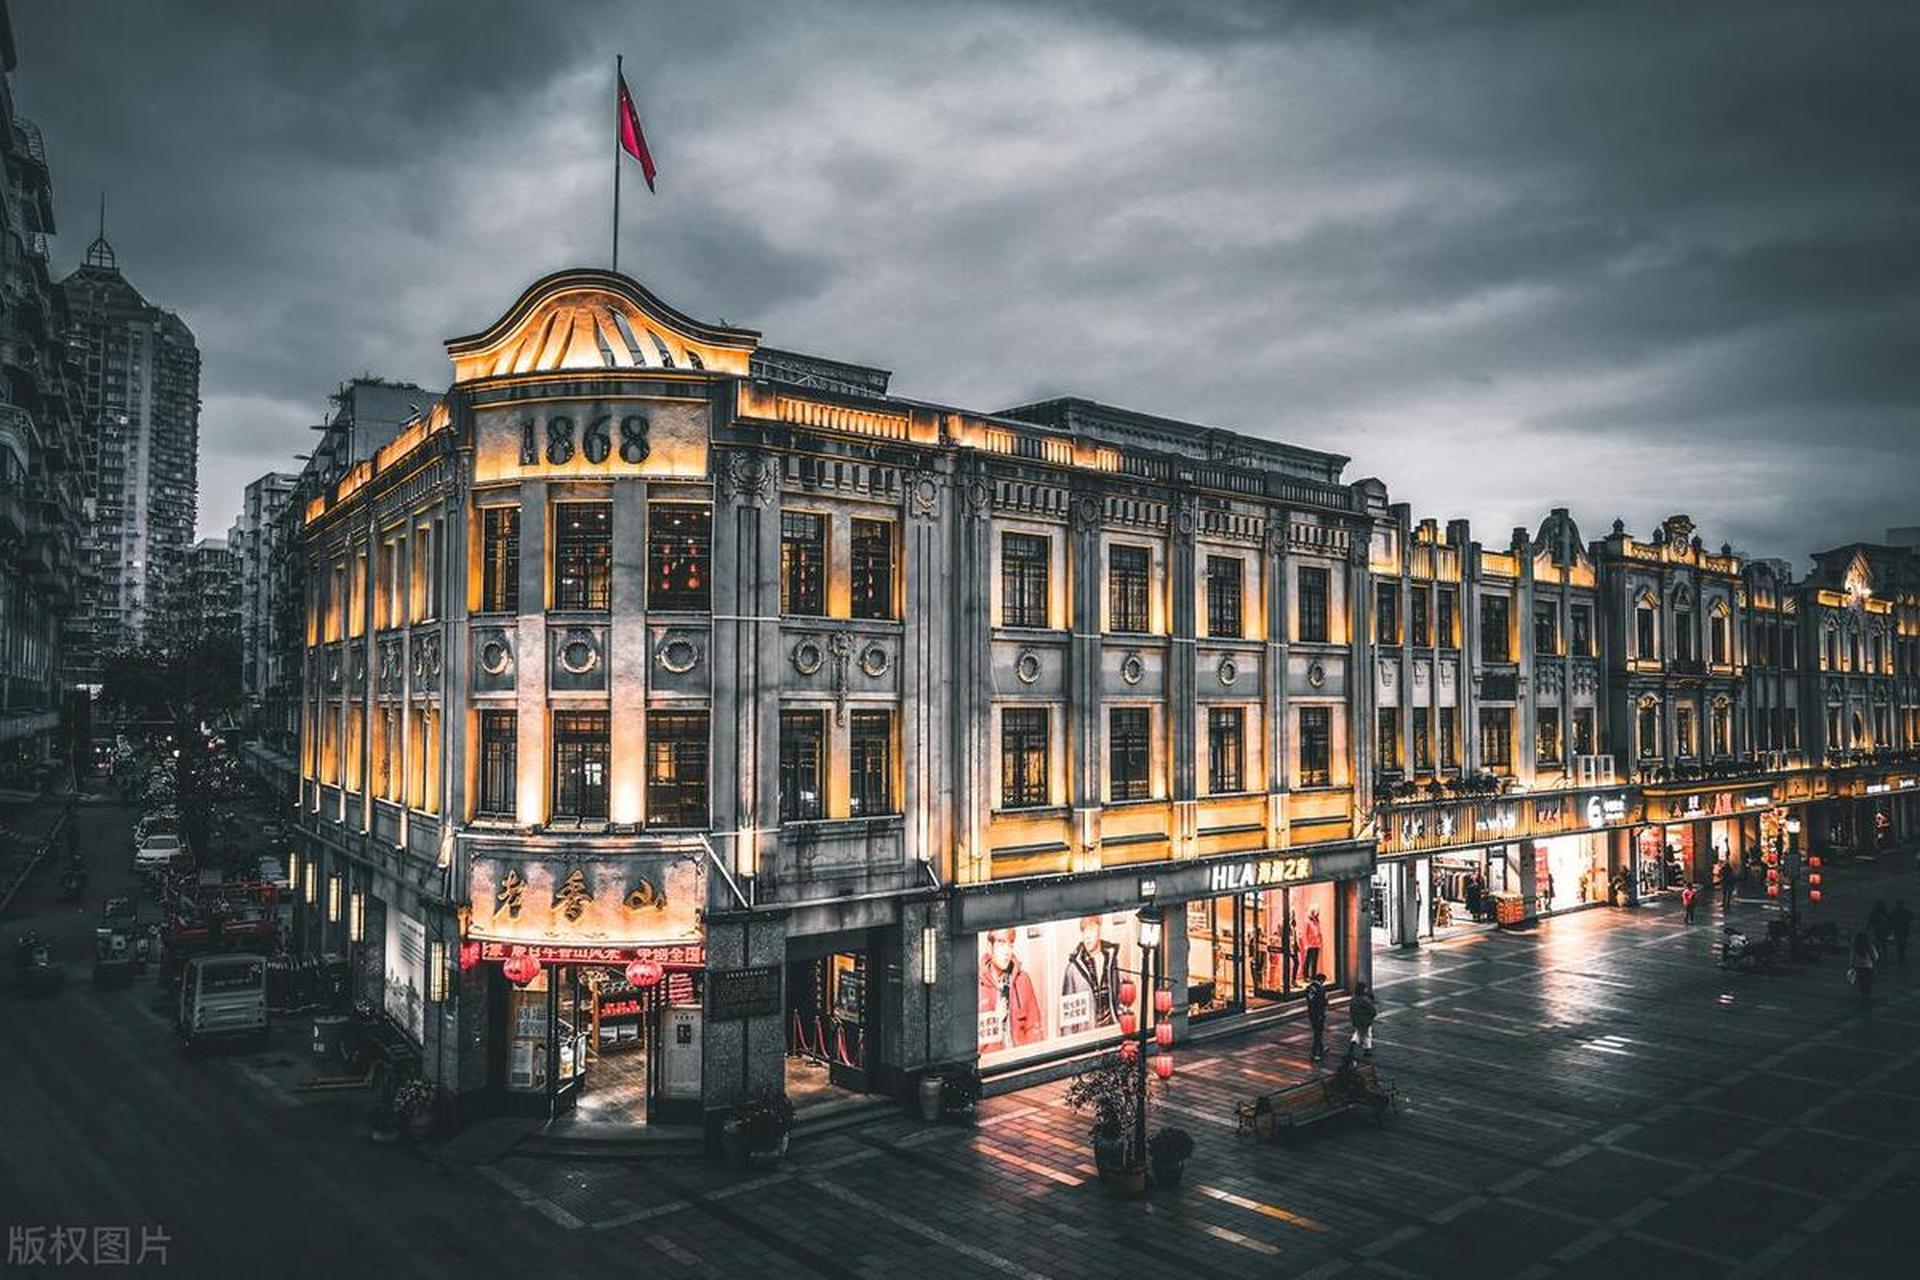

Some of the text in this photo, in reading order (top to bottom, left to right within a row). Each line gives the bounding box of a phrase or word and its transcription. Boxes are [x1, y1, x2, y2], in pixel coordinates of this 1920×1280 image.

[518, 413, 651, 466] 1868
[493, 868, 668, 922] 老香山
[1211, 862, 1255, 891] HLA
